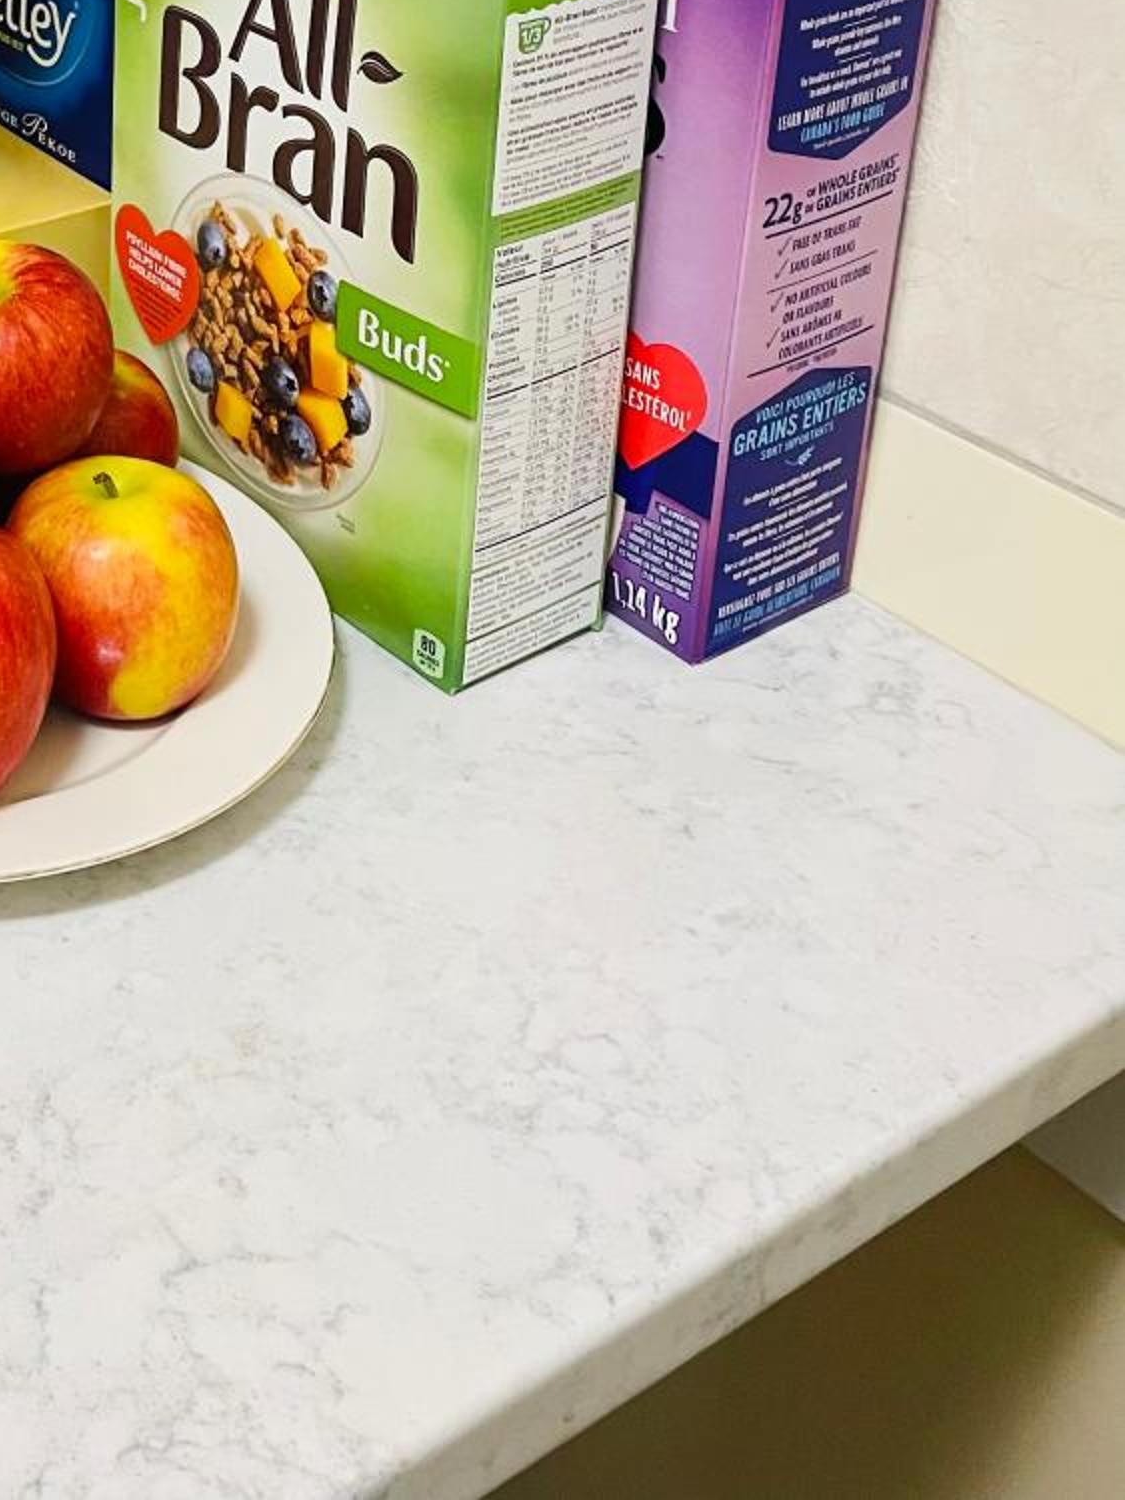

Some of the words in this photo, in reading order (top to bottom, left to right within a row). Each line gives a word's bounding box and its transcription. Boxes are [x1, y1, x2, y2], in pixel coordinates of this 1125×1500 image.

[158, 4, 419, 265] Bran
[356, 307, 445, 384] Buds
[625, 356, 661, 391] SANS
[836, 371, 856, 392] LES
[733, 413, 799, 457] GRAINS
[801, 381, 867, 429] ENTIERS
[651, 596, 680, 646] kg
